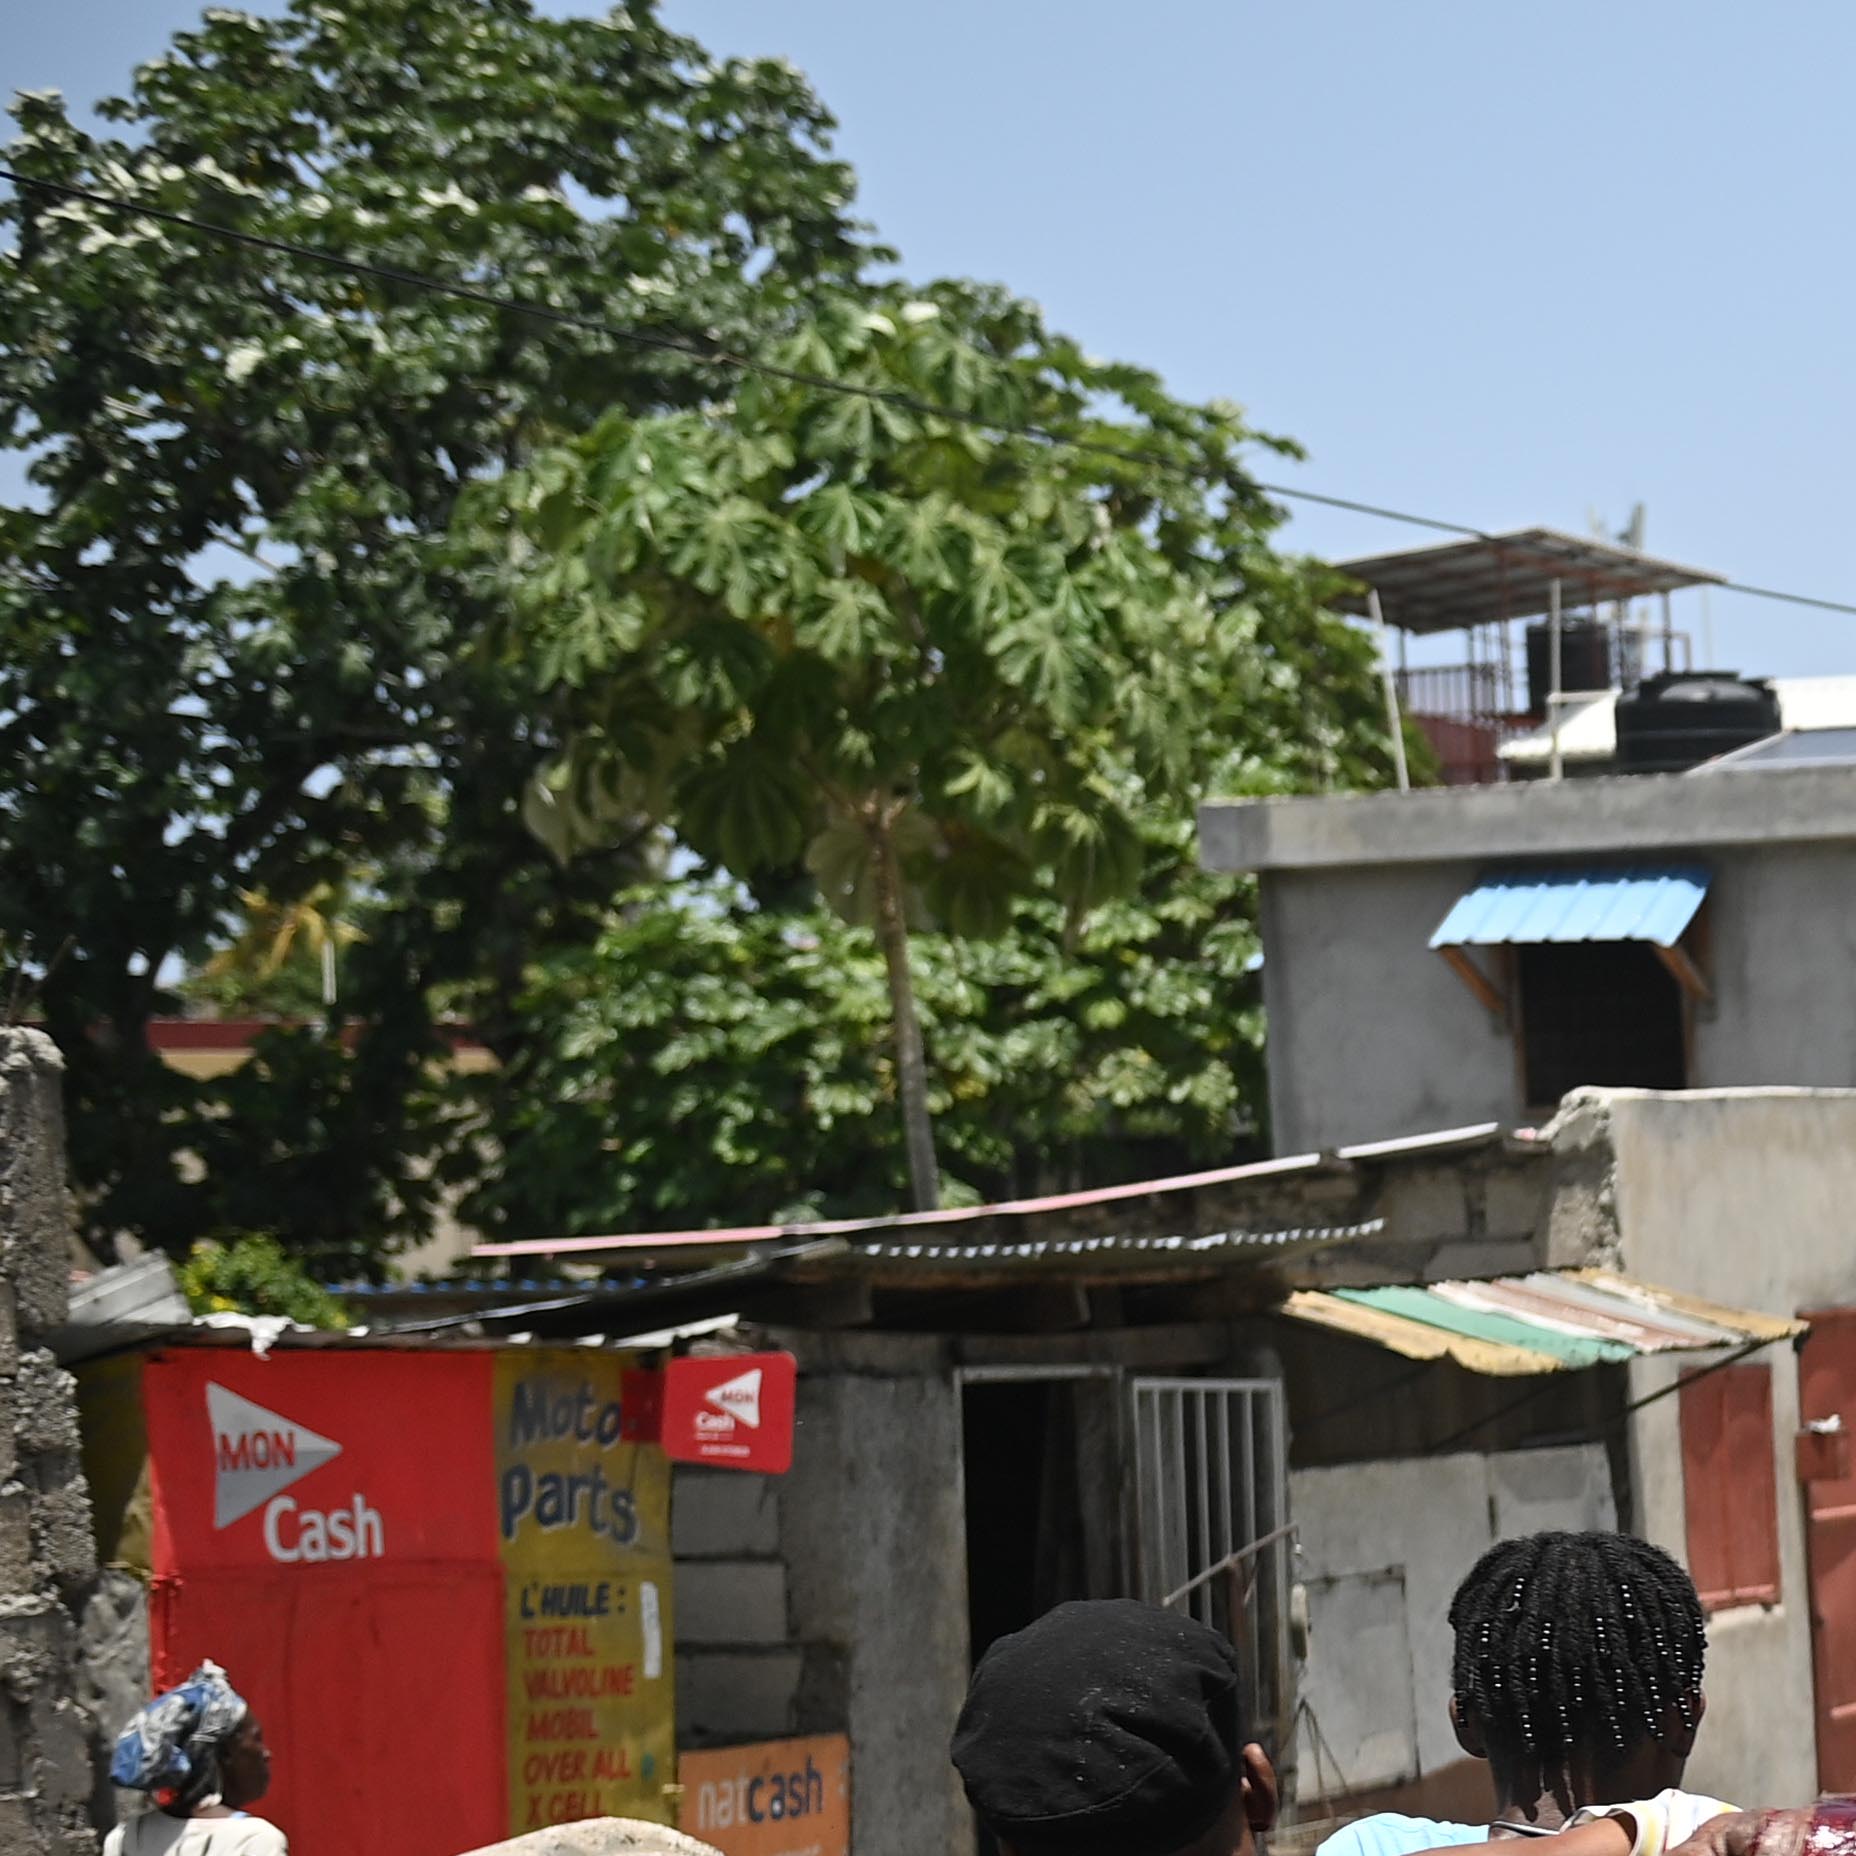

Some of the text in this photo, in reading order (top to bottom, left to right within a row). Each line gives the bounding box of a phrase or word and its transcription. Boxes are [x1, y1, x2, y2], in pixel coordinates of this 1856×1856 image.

[511, 1378, 623, 1451] Moto
[219, 1430, 296, 1471] MON
[502, 1461, 641, 1547] Parts
[263, 1492, 385, 1563] Cash
[522, 1625, 596, 1659] TOTAL
[523, 1664, 636, 1699] VALVOLINE
[525, 1706, 599, 1742] MOBIL
[524, 1744, 631, 1786] OVER ALL
[696, 1753, 824, 1832] natcash
